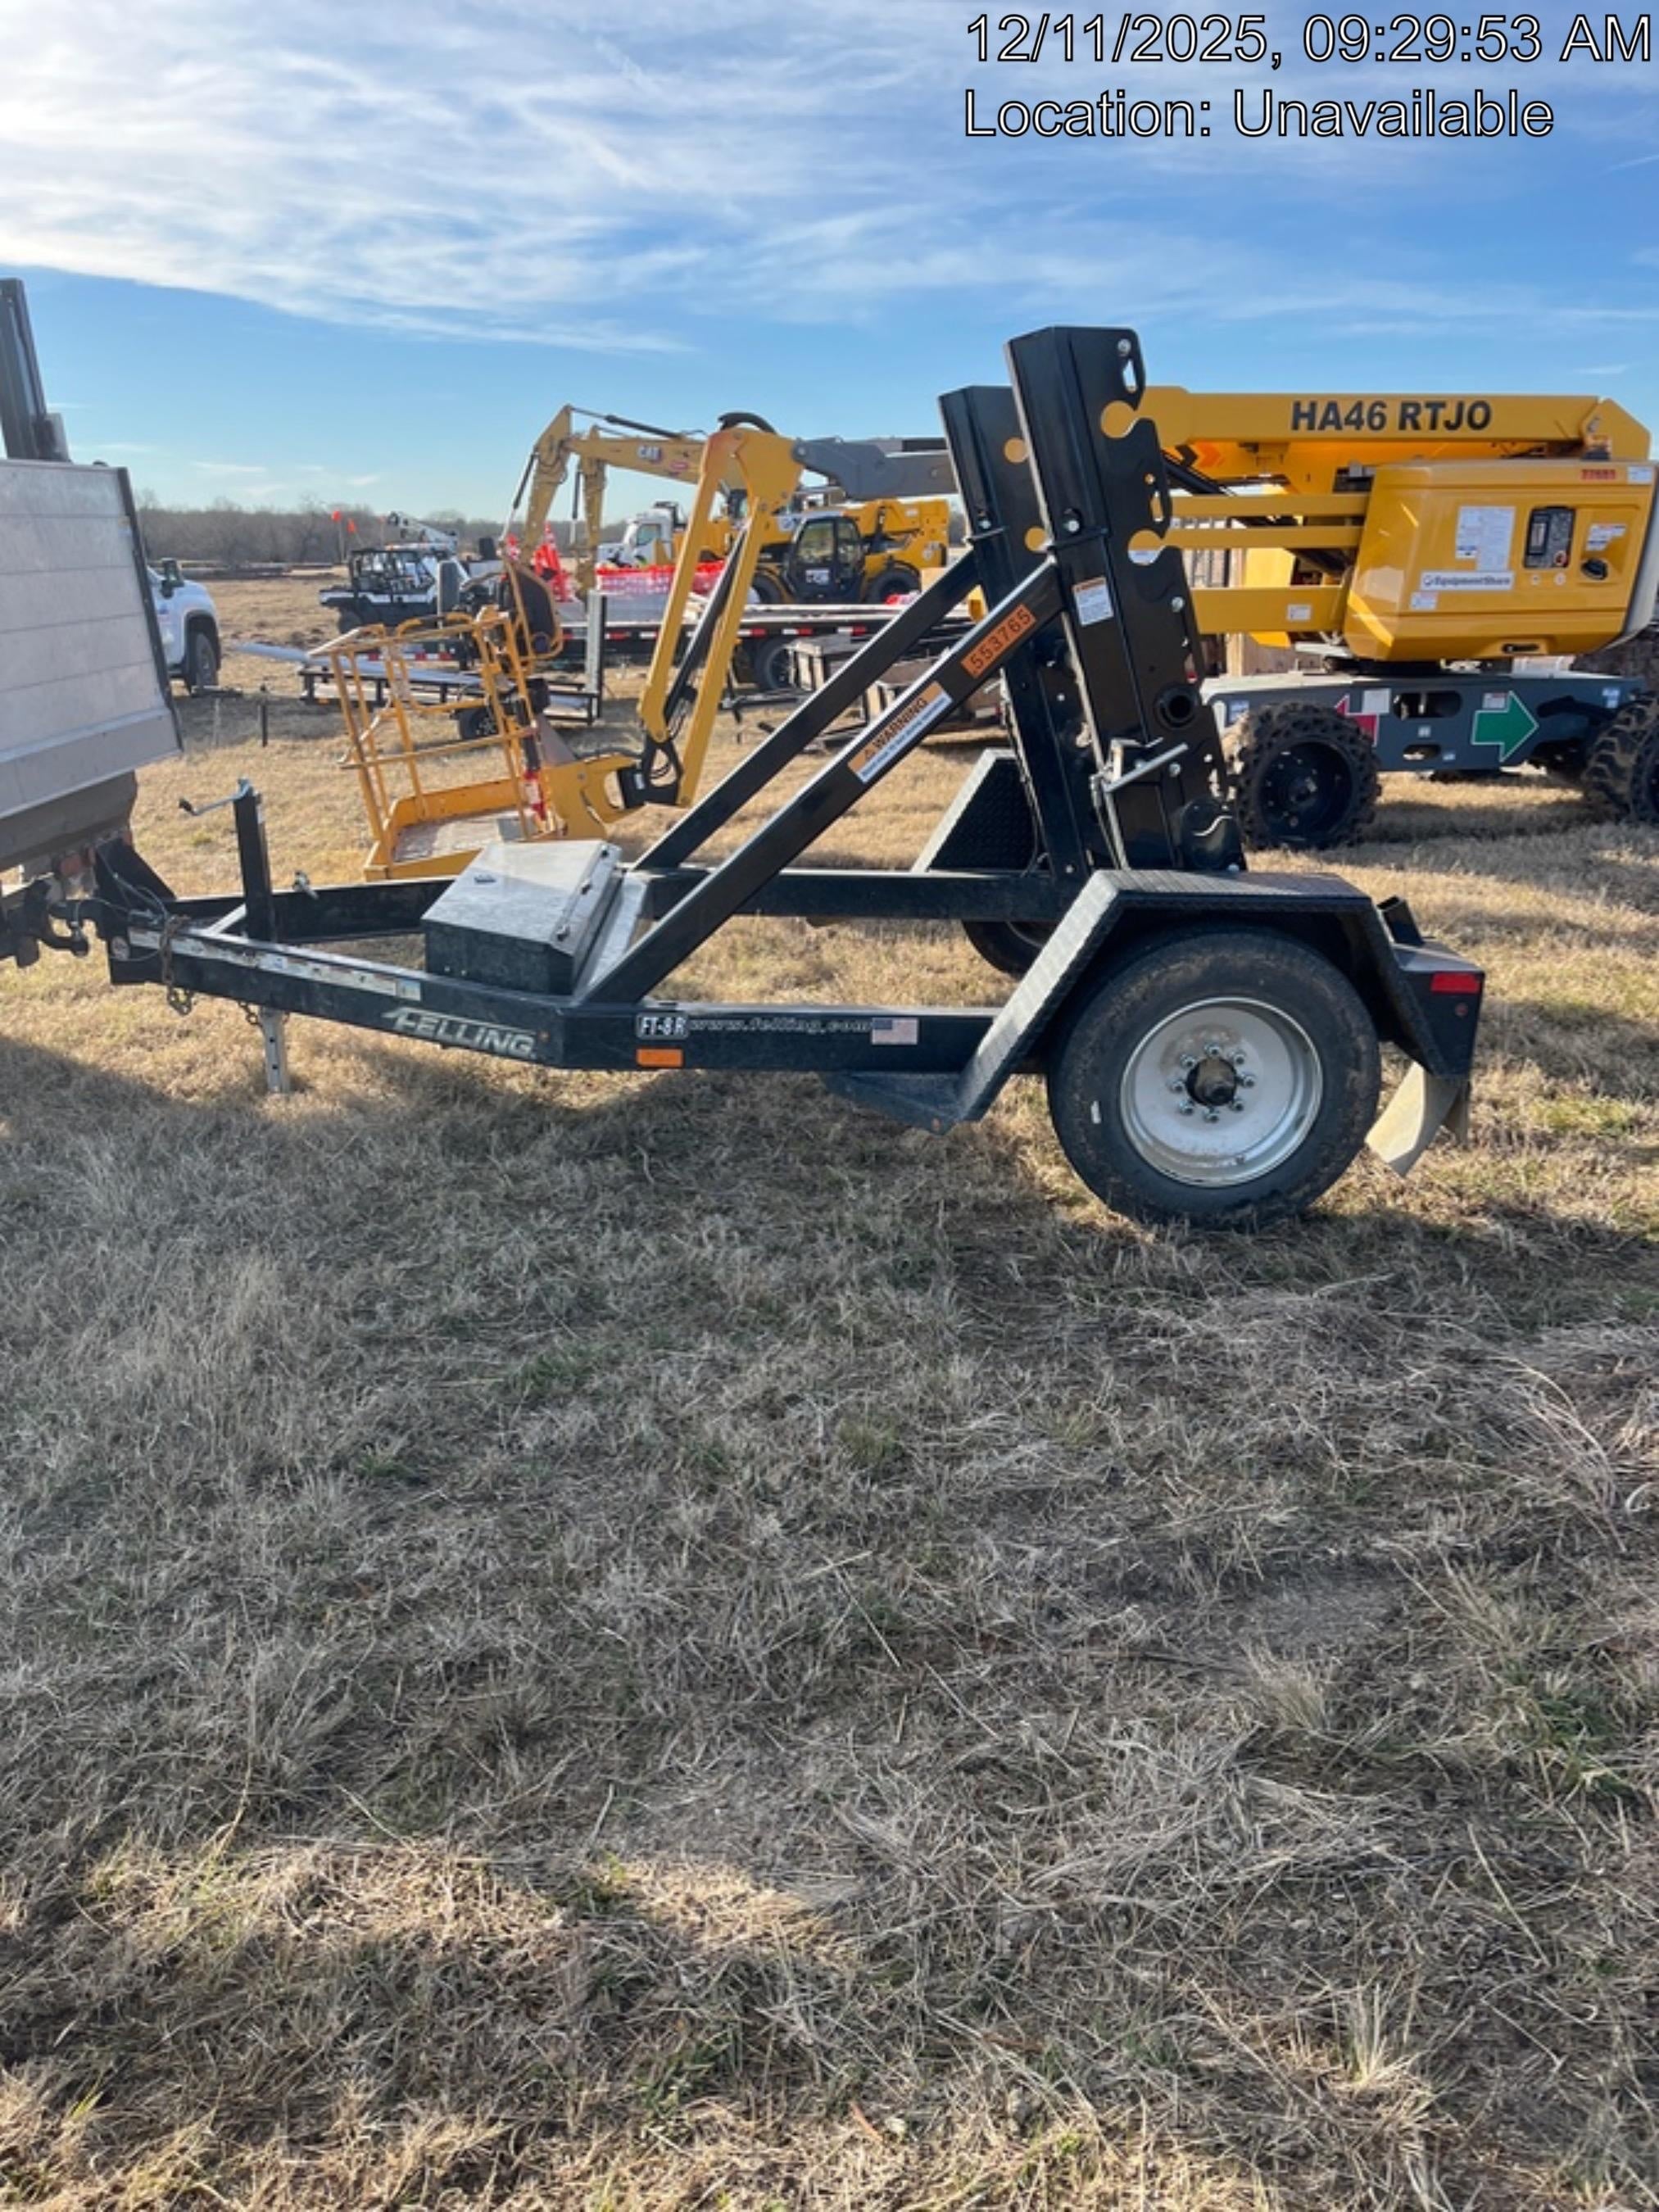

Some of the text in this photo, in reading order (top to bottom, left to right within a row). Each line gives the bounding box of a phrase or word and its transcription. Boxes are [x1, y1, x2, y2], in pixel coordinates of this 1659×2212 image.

[1290, 400, 1492, 432] HA46 RTJO
[970, 608, 1031, 670] 553765
[871, 696, 927, 749] WARNING
[381, 1007, 536, 1059] FELLING
